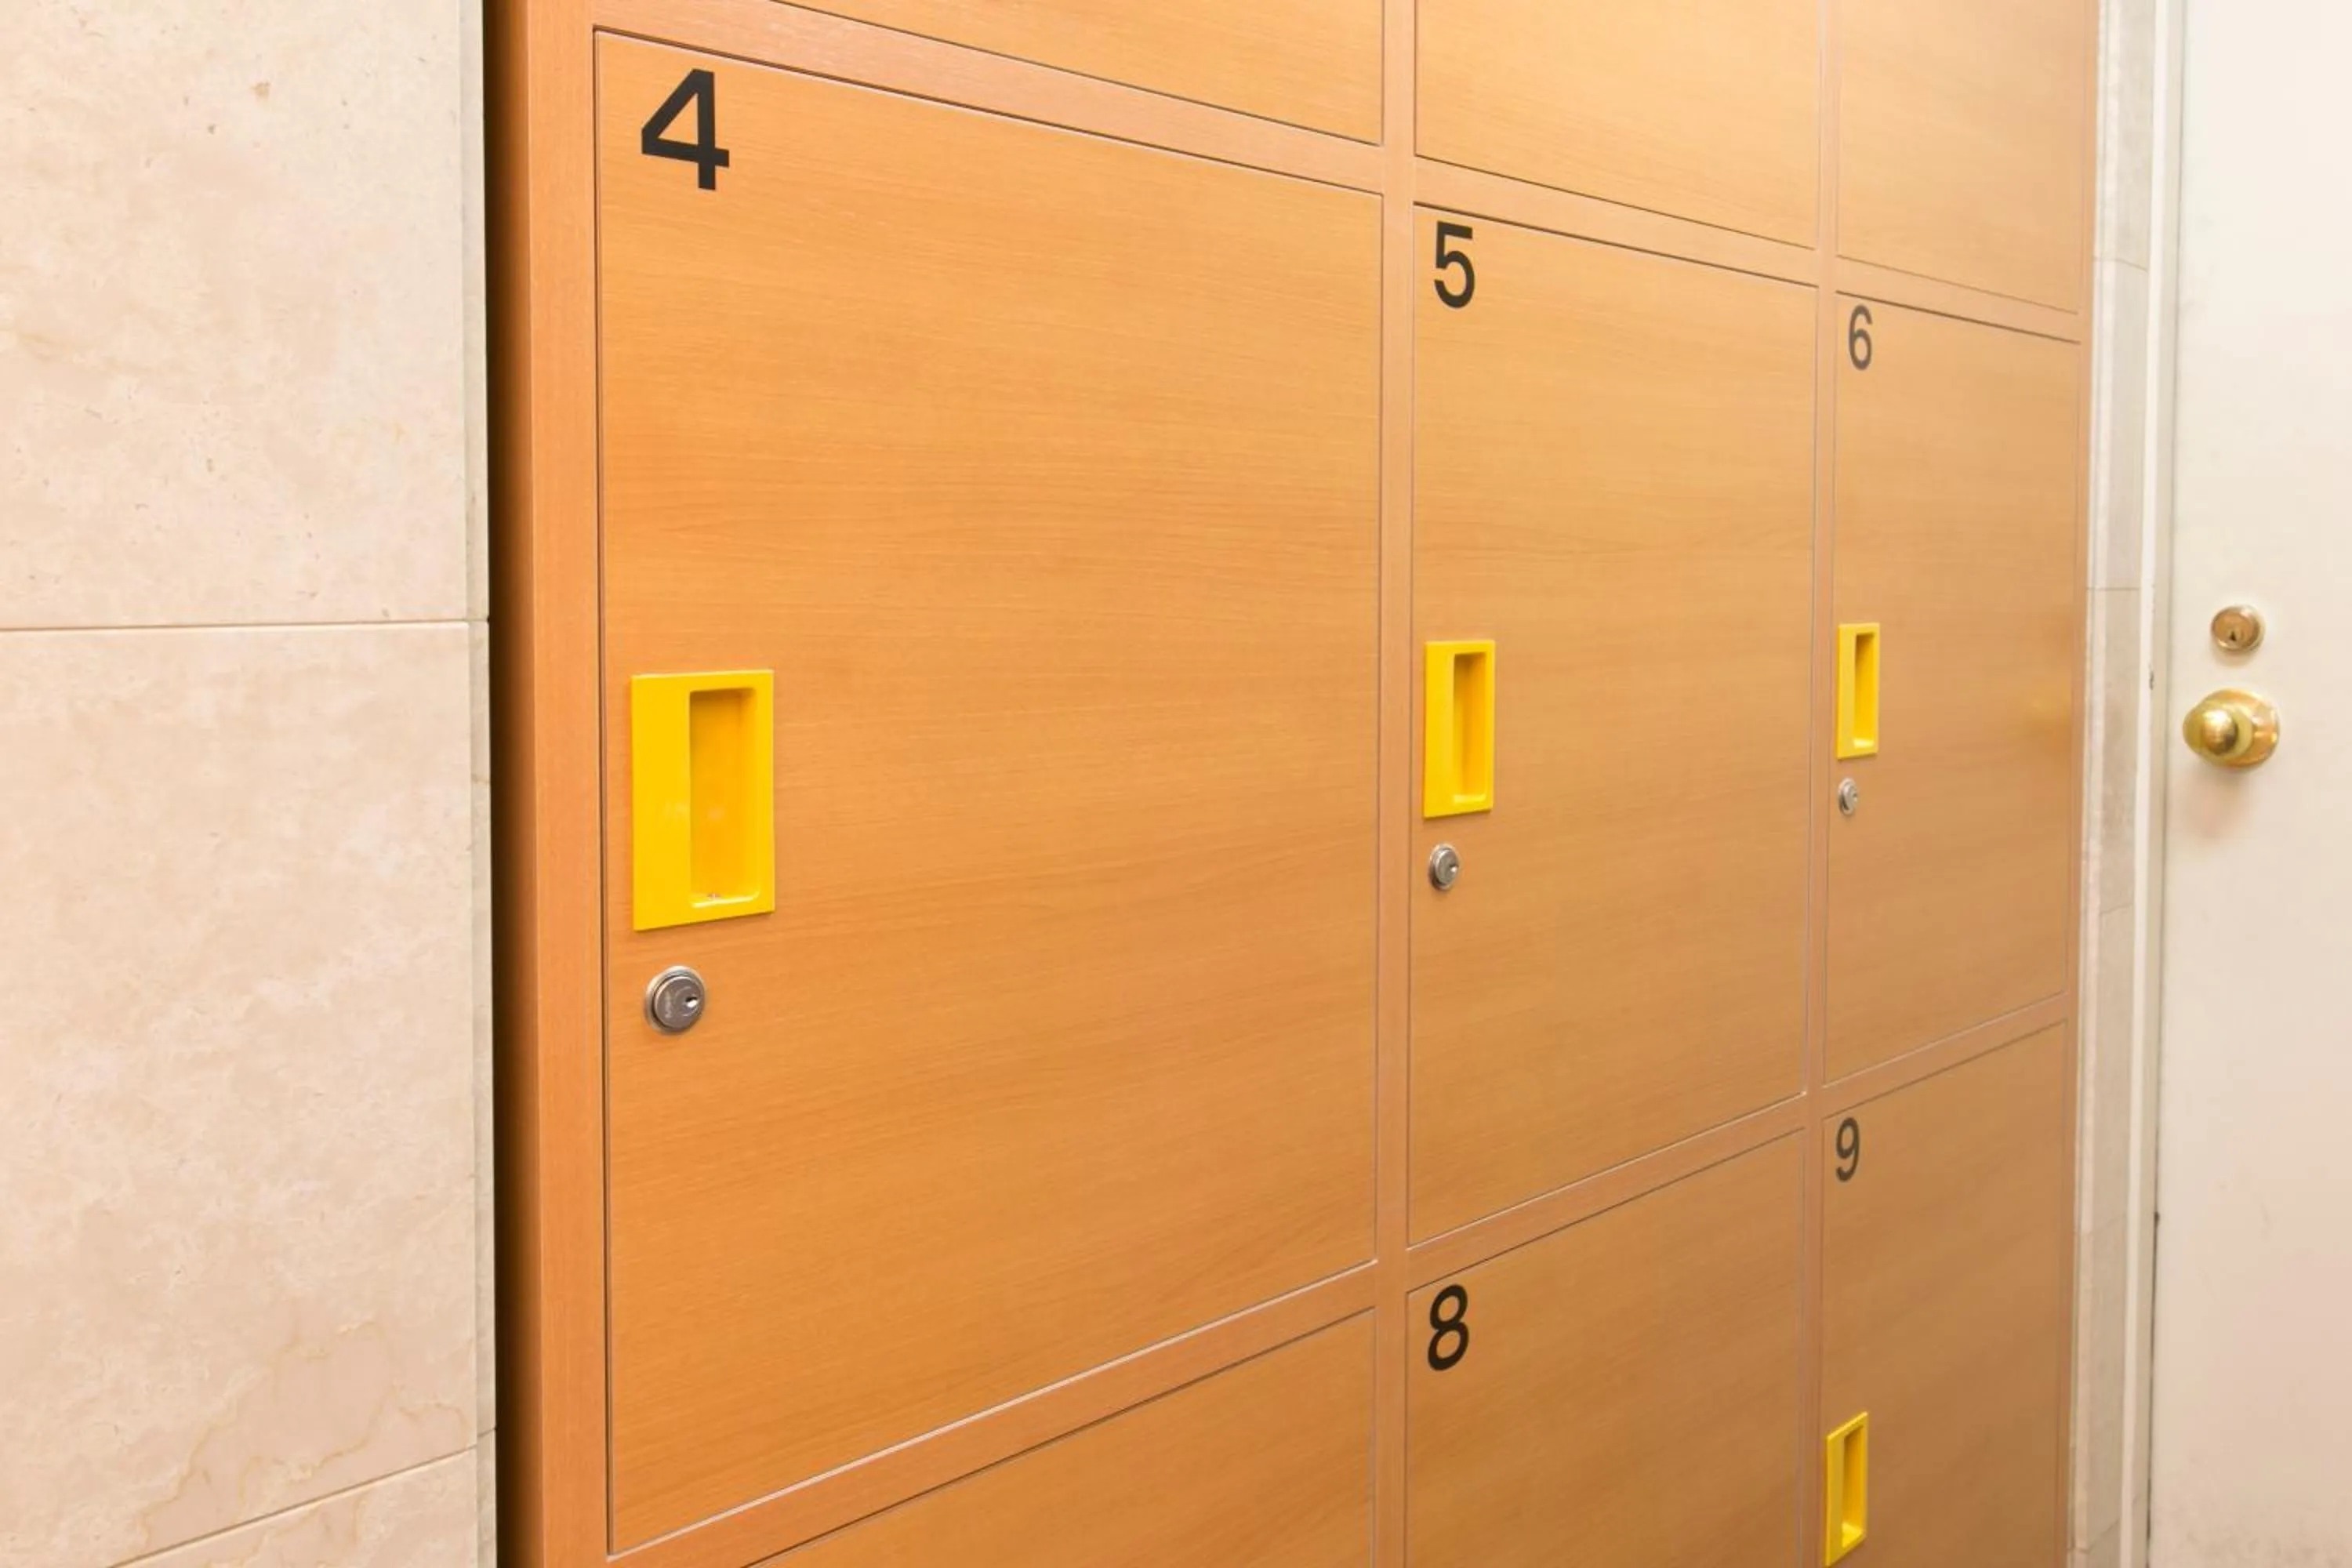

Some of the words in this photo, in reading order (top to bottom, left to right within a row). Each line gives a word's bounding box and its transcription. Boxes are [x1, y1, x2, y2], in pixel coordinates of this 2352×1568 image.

[641, 69, 729, 191] 4
[1434, 221, 1475, 309] 5
[1848, 304, 1872, 371] 6
[1835, 1116, 1860, 1182] 9
[1428, 1284, 1469, 1371] 8
